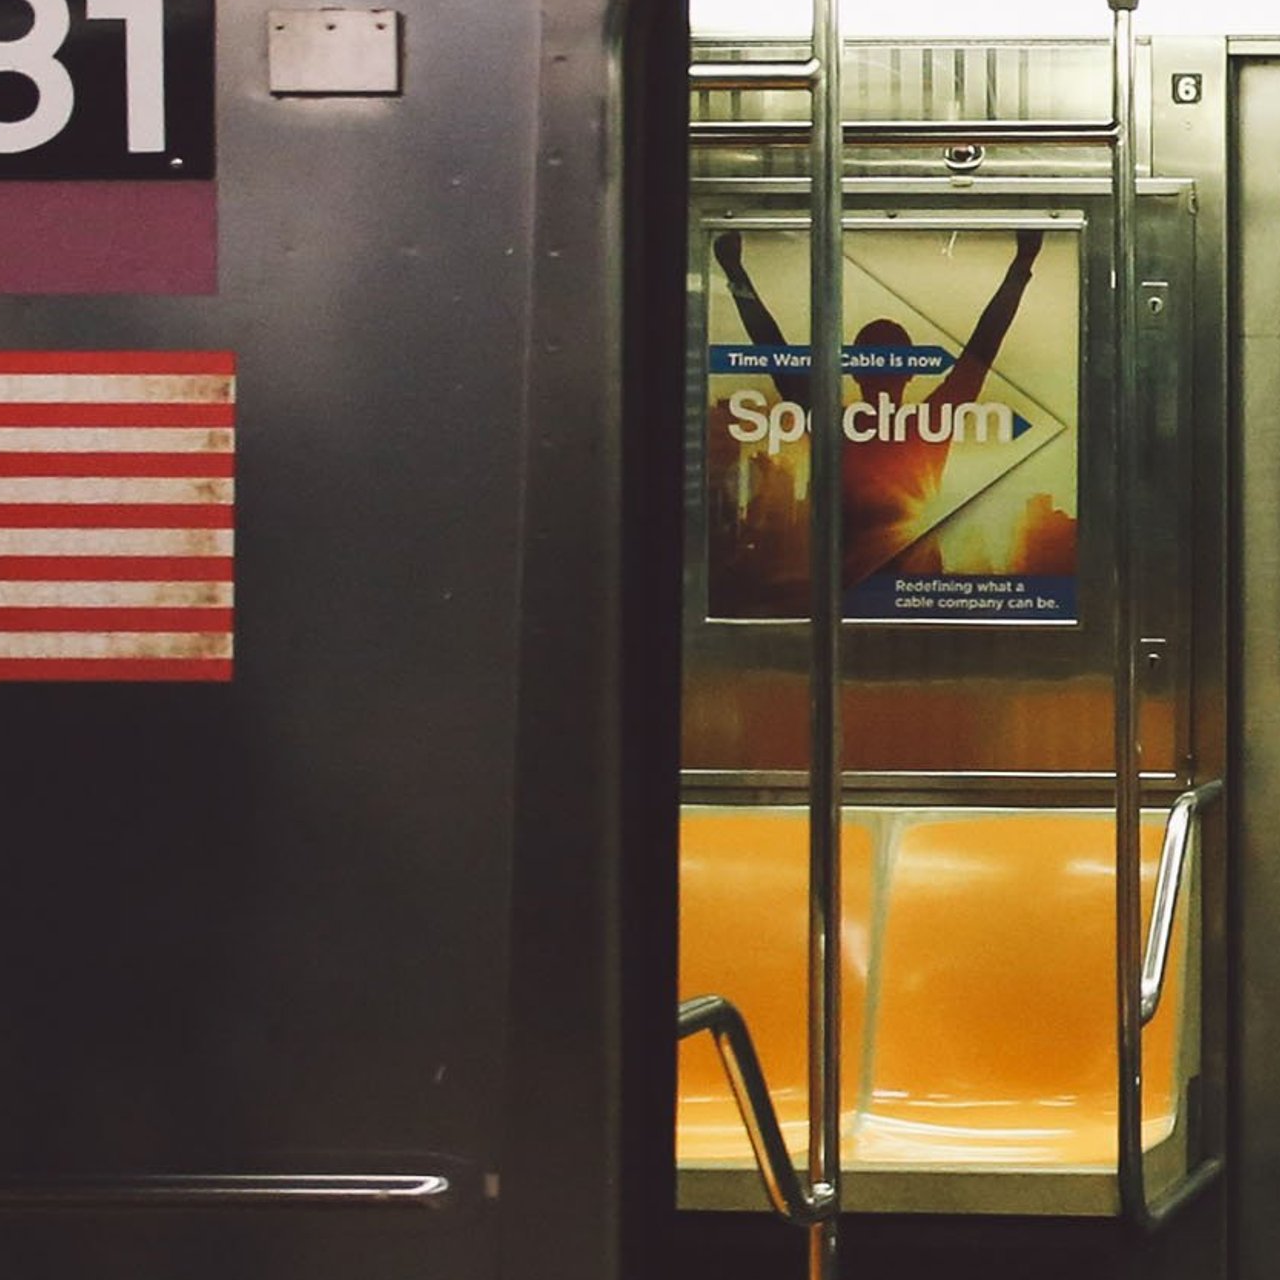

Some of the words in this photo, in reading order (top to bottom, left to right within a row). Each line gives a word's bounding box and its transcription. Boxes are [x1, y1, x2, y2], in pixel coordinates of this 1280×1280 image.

[1177, 76, 1198, 101] 6
[728, 352, 768, 367] Time
[840, 352, 885, 367] Cable
[889, 352, 903, 367] is
[907, 356, 942, 367] now
[728, 389, 1013, 455] Spctrum
[895, 580, 973, 595] Redefining
[977, 580, 1012, 593] what
[1016, 582, 1025, 593] a
[895, 596, 933, 609] cable
[937, 598, 1005, 611] company
[1008, 598, 1033, 609] can
[1037, 597, 1060, 609] be.
